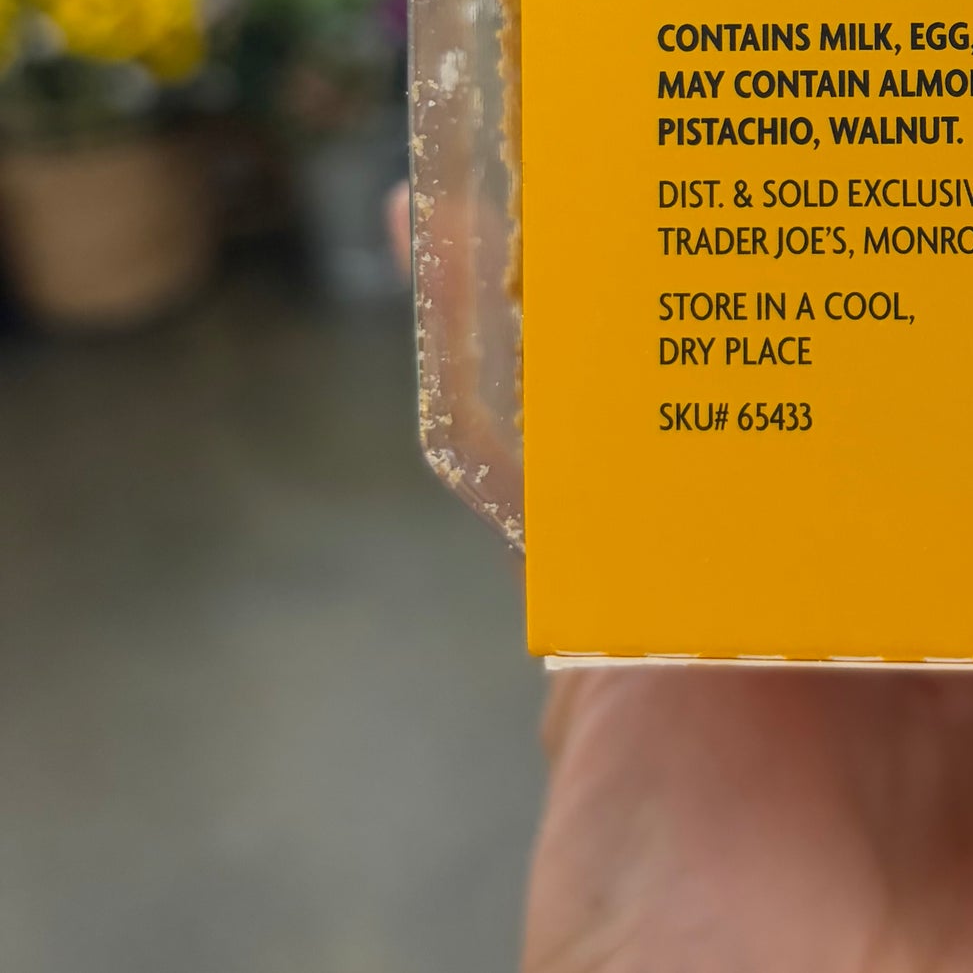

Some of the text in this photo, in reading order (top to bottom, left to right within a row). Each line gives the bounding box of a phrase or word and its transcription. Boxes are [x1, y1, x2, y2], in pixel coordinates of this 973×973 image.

[658, 23, 810, 52] CONTAINS
[820, 23, 901, 55] MILK,
[658, 71, 724, 98] MAY
[734, 70, 869, 98] CONTAIN
[659, 116, 963, 150] PISTACHIO, WALNUT.
[660, 180, 723, 208] DIST.
[734, 180, 753, 208] &
[763, 180, 838, 207] SOLD
[658, 227, 769, 255] TRADER
[774, 227, 854, 259] JOE'S,
[660, 292, 914, 324] STORE IN A COOL,
[660, 337, 811, 365] DRY PLACE
[660, 403, 812, 431] SKU# 65433
